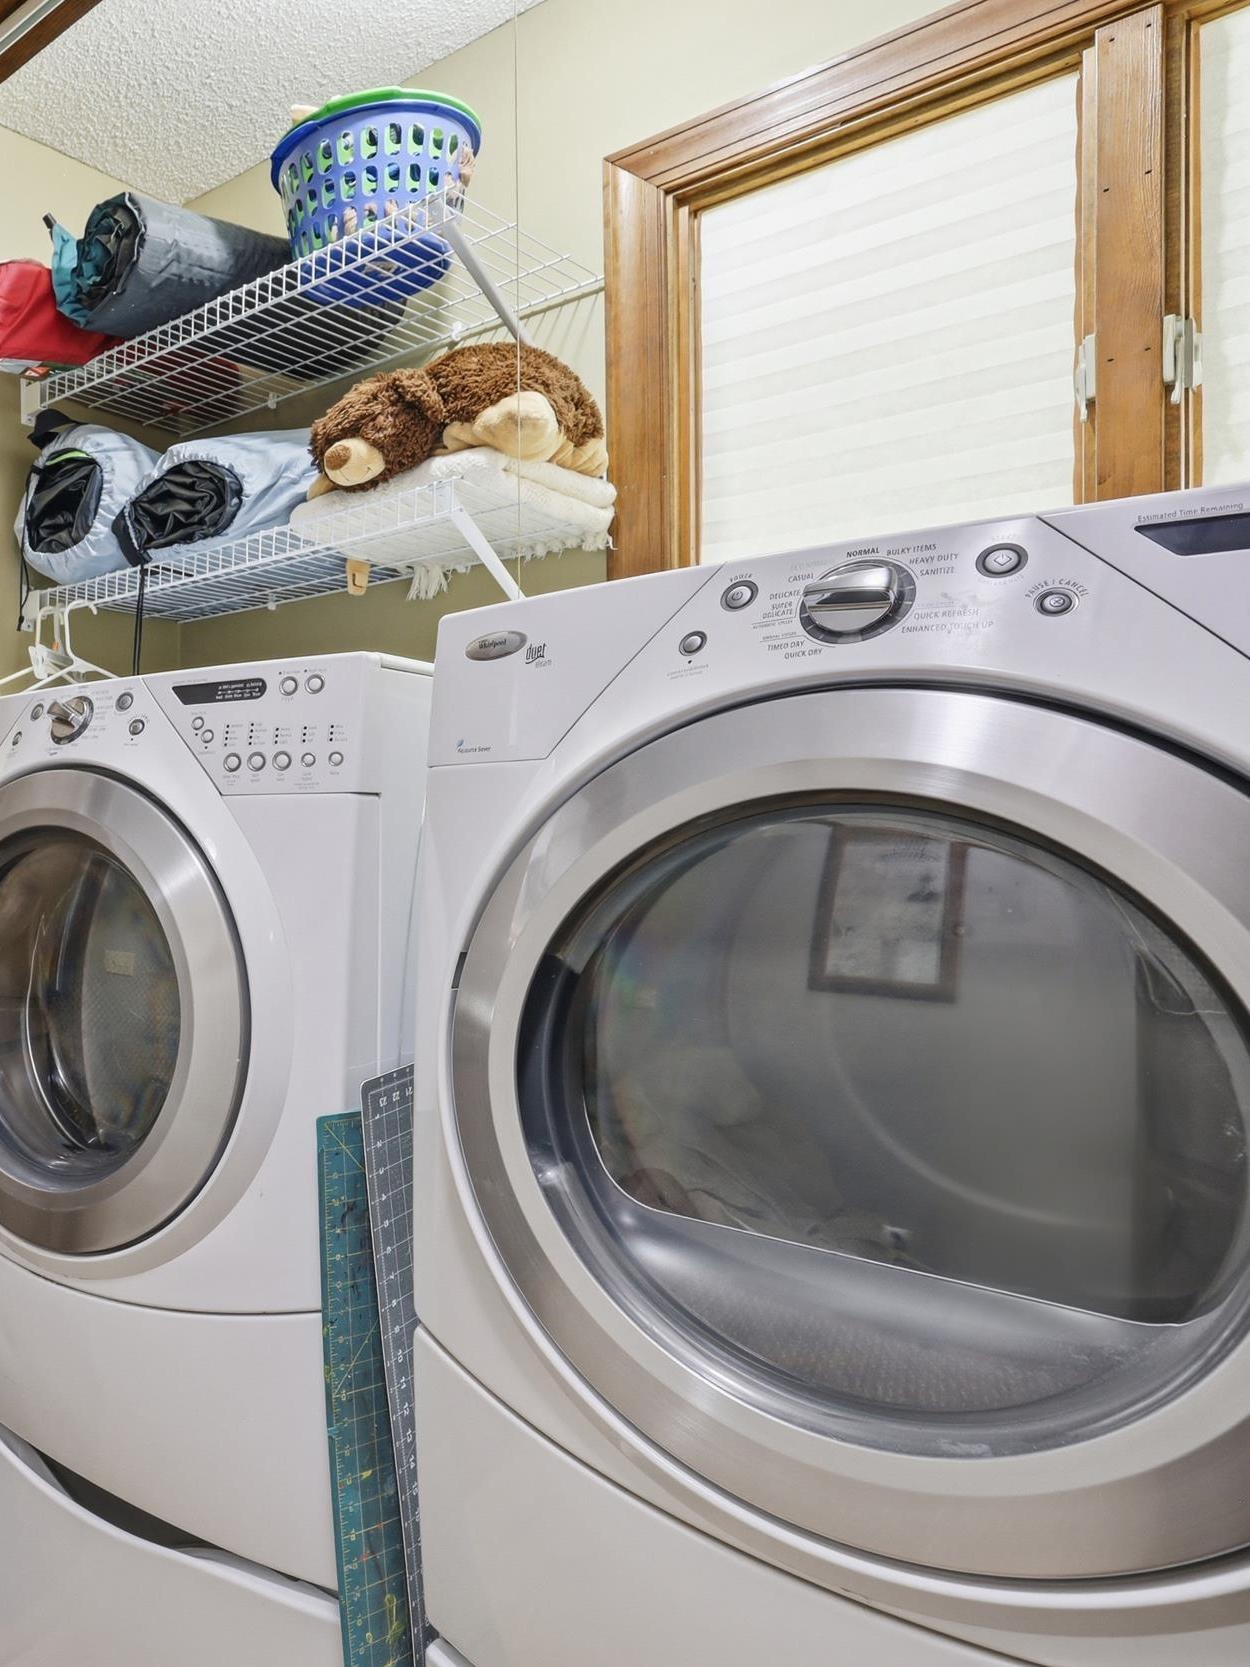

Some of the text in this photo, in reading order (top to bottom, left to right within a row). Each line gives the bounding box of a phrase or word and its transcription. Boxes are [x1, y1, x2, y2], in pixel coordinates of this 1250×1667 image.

[1137, 502, 1244, 522] Estimated Time Remaining
[846, 547, 880, 558] NORMAL
[886, 543, 937, 557] BULKY ITEMS
[909, 553, 959, 565] HEAVY DUTY
[919, 566, 955, 577] SANITIZE
[788, 573, 814, 583] CASUAL
[1025, 581, 1049, 598] PAUSE
[1058, 578, 1089, 597] CANCEL
[770, 589, 801, 600] DELICATE
[762, 608, 793, 619] DELICATE
[914, 608, 980, 620] QUICK REFRESH
[901, 620, 994, 634] ENHANCED TOUCH UP
[767, 640, 805, 651] TIMED DRY
[525, 642, 547, 661] duet
[784, 648, 823, 659] QUICK DRY
